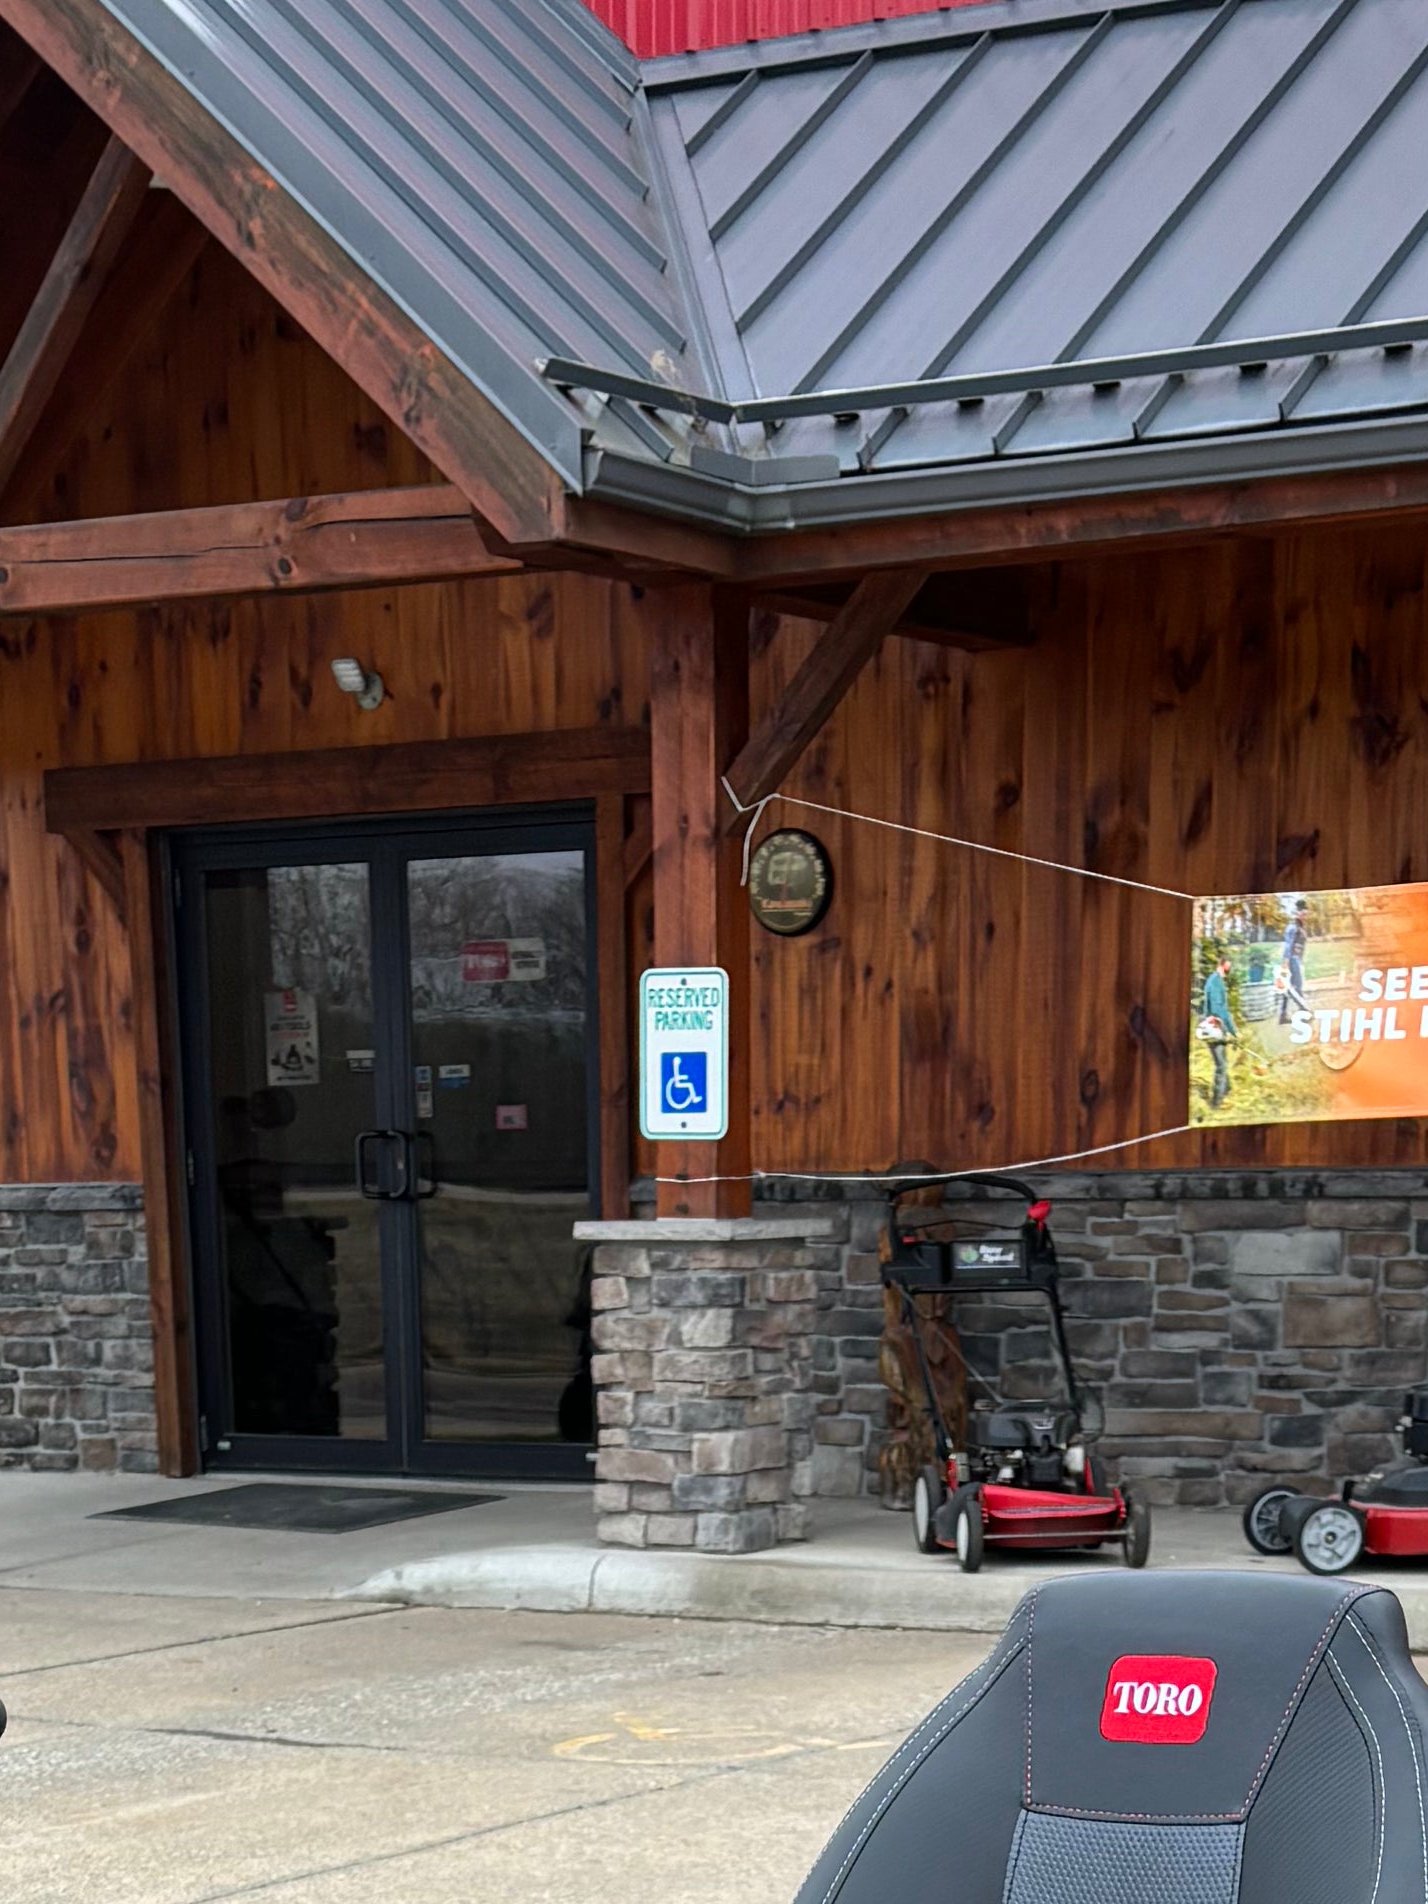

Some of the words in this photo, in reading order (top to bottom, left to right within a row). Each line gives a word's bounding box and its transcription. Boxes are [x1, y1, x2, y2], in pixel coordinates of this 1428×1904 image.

[647, 986, 720, 1008] RESERVED
[654, 1009, 714, 1032] PARKING
[1289, 1003, 1406, 1044] STIHL
[1113, 1681, 1203, 1717] TORO
